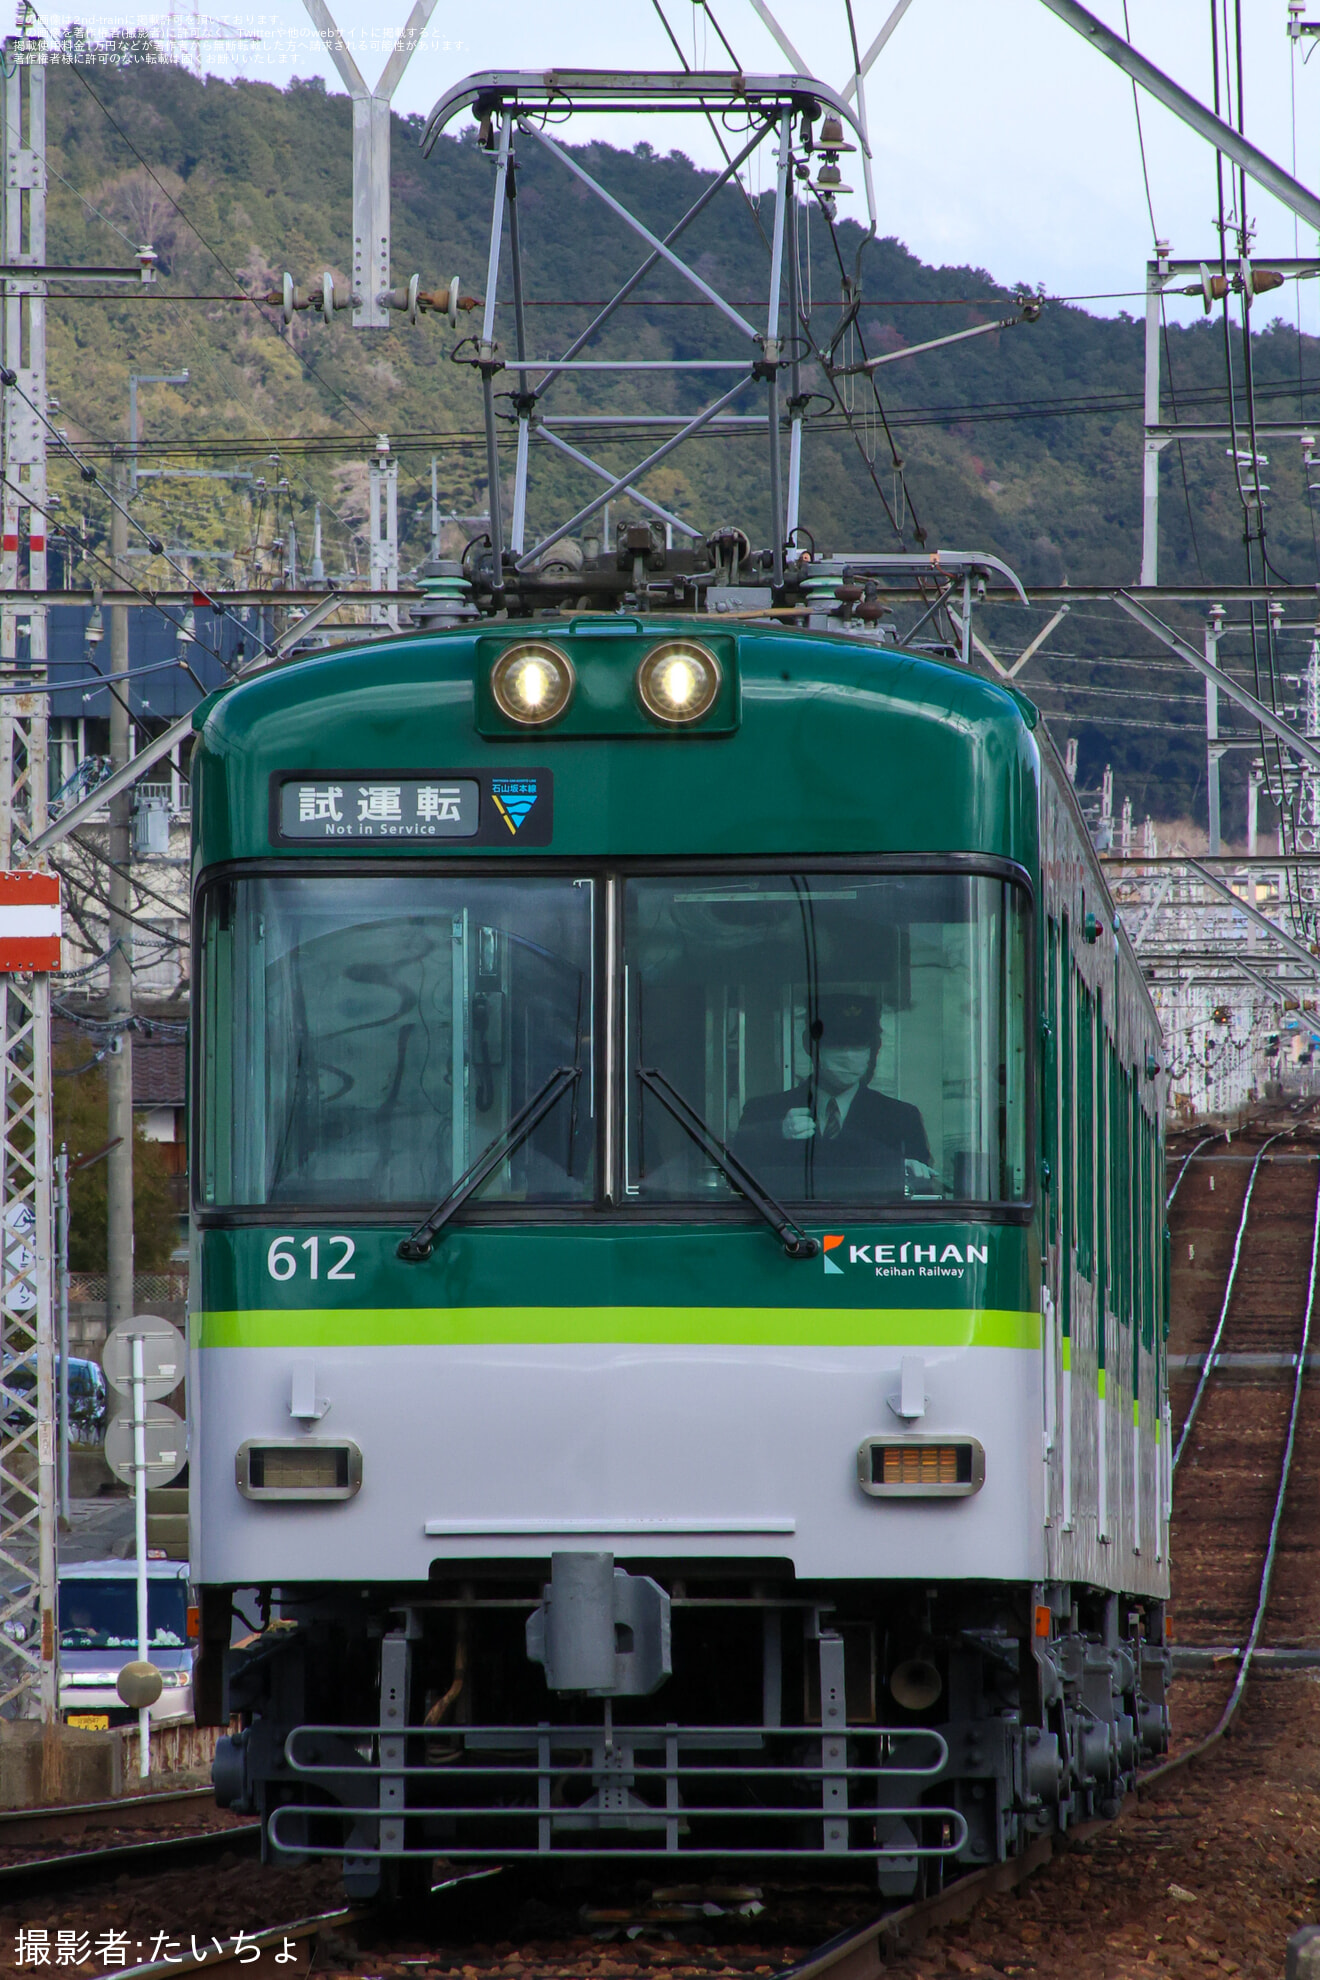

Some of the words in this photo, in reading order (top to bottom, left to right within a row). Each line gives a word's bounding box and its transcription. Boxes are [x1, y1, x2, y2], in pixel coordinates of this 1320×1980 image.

[298, 786, 461, 823] 試運転
[325, 824, 352, 835] Not
[358, 824, 373, 835] in
[380, 824, 436, 835] Service
[267, 1235, 356, 1281] 612
[848, 1241, 989, 1265] KEIHAN
[875, 1267, 915, 1277] Keihan
[919, 1267, 964, 1279] Railway
